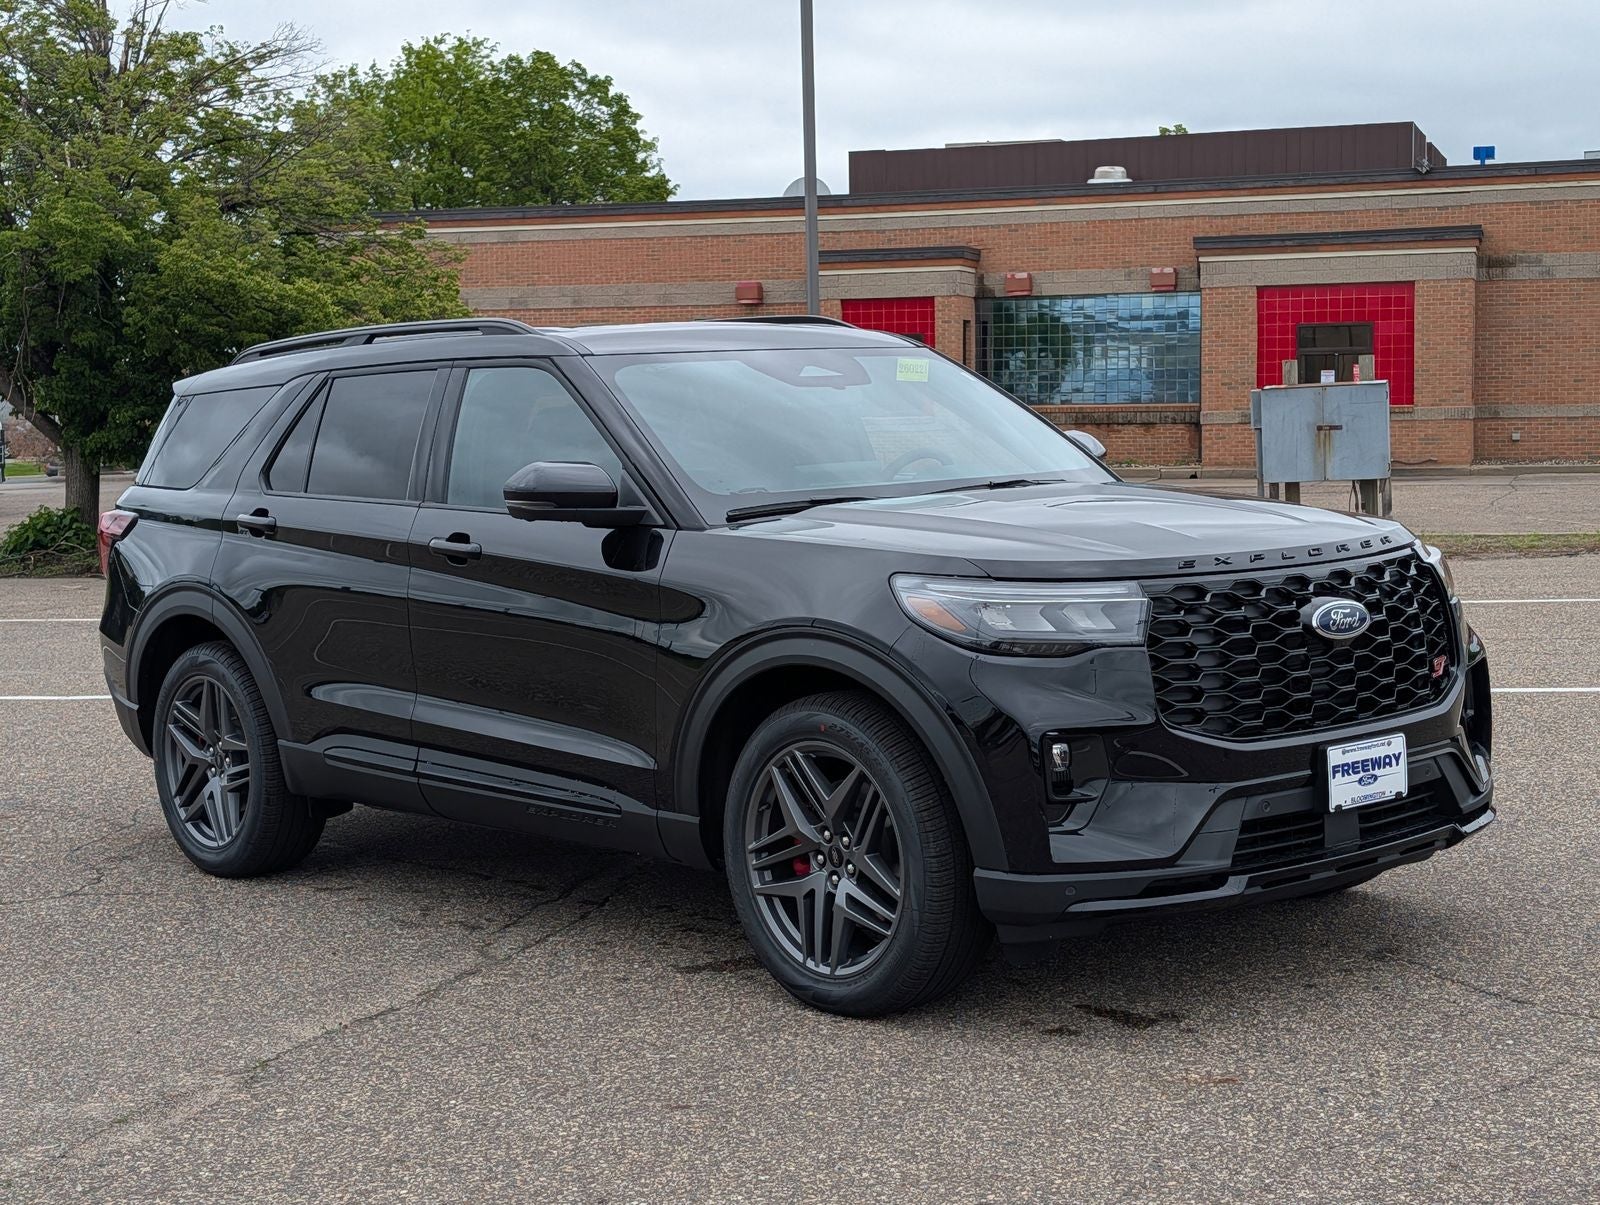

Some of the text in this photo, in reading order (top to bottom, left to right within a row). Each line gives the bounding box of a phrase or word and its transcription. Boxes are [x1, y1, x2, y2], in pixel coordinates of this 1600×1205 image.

[1178, 535, 1393, 570] EXPLORER
[1329, 608, 1361, 631] Ford
[1331, 752, 1402, 780] FREEWAY
[1359, 774, 1377, 786] Ford
[1351, 791, 1386, 804] BLOOMINGTON
